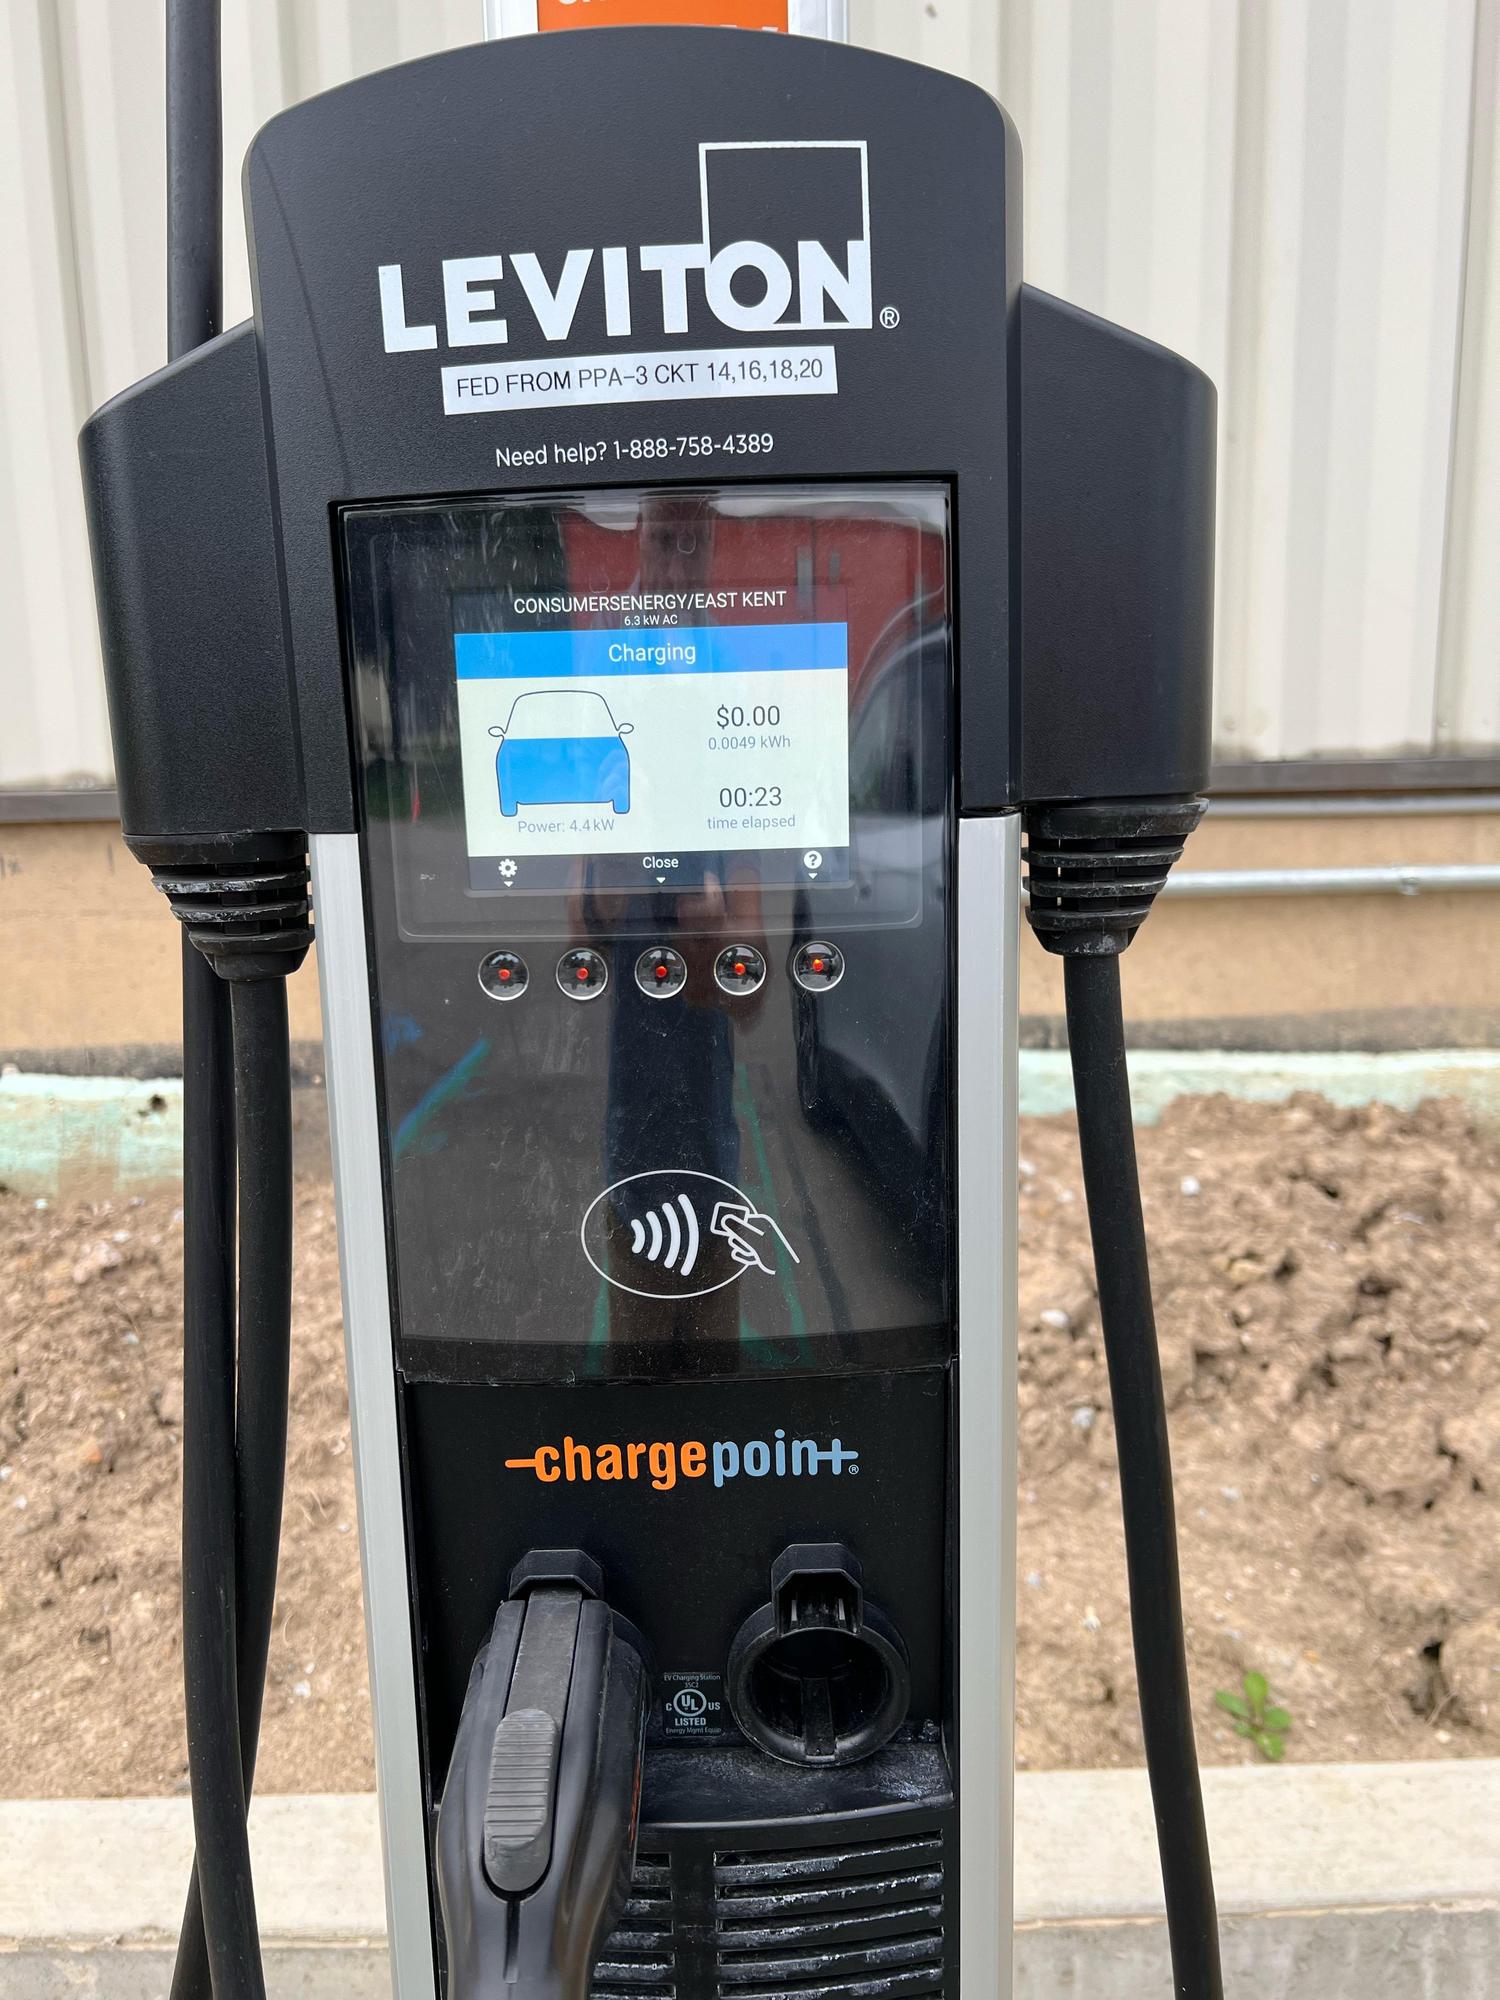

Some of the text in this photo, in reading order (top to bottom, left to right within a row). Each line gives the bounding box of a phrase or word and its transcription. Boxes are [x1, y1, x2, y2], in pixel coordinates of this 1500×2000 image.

[378, 240, 873, 353] LEVITON
[456, 359, 823, 398] FED FROM PPA-3 CKT 14,16,18,20
[495, 434, 774, 467] Need help? 1-888-758-4389
[513, 590, 787, 614] CONSUMERSENERGY/EAST KENT
[623, 614, 678, 626] 6.3 kW AC
[608, 643, 697, 665] Charging
[716, 704, 781, 730] $0.00
[707, 734, 791, 751] 0.0049 kWh
[719, 786, 783, 808] 00:23
[517, 816, 615, 834] Power: 4.4 kW
[707, 814, 796, 830] time elapsed
[642, 855, 679, 869] Close
[699, 1673, 721, 1681] Station
[681, 1694, 699, 1711] UL
[708, 1701, 721, 1711] US
[674, 1717, 706, 1726] LISTED
[665, 1727, 686, 1735] Energy
